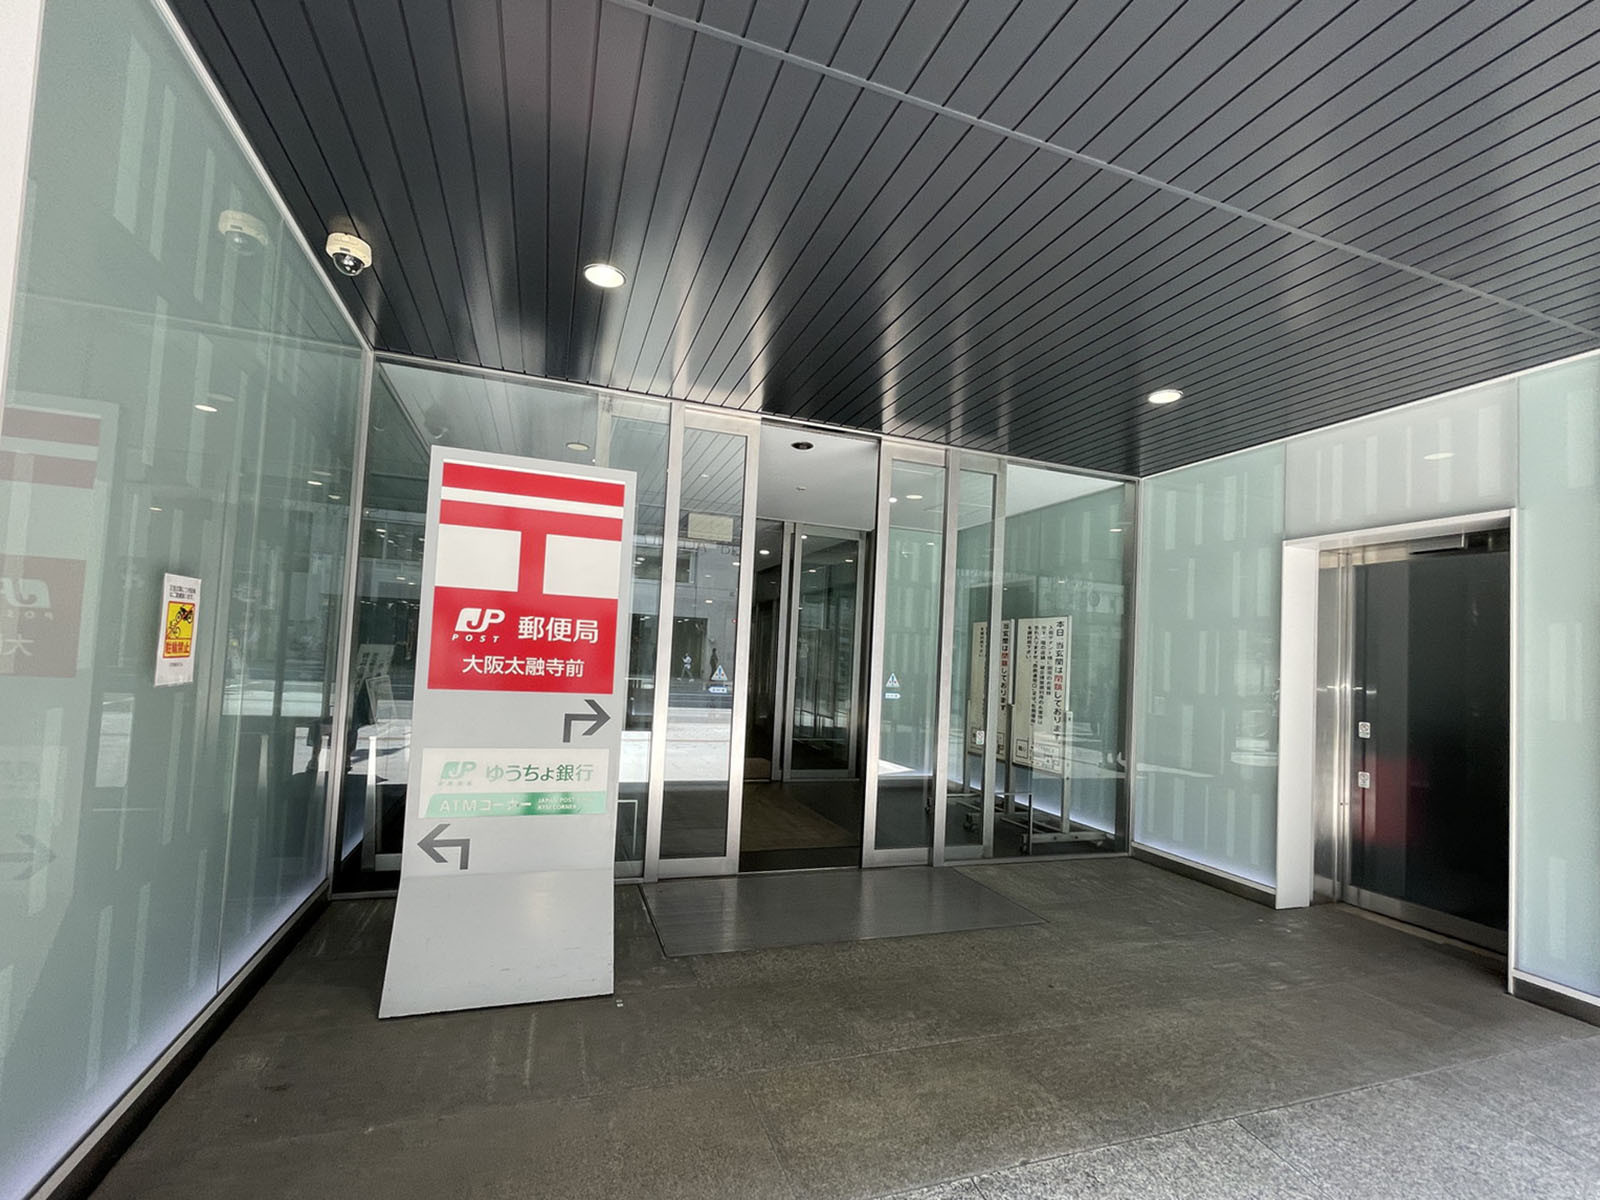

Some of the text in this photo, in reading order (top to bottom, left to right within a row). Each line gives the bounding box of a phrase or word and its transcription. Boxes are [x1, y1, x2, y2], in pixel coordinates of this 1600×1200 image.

[454, 607, 505, 633] JP
[518, 616, 599, 644] 郵便局
[451, 634, 500, 643] POST
[462, 655, 585, 678] 大阪太融寺前
[486, 763, 594, 783] ゆうちょ銀行
[440, 797, 532, 812] ATMコーナー
